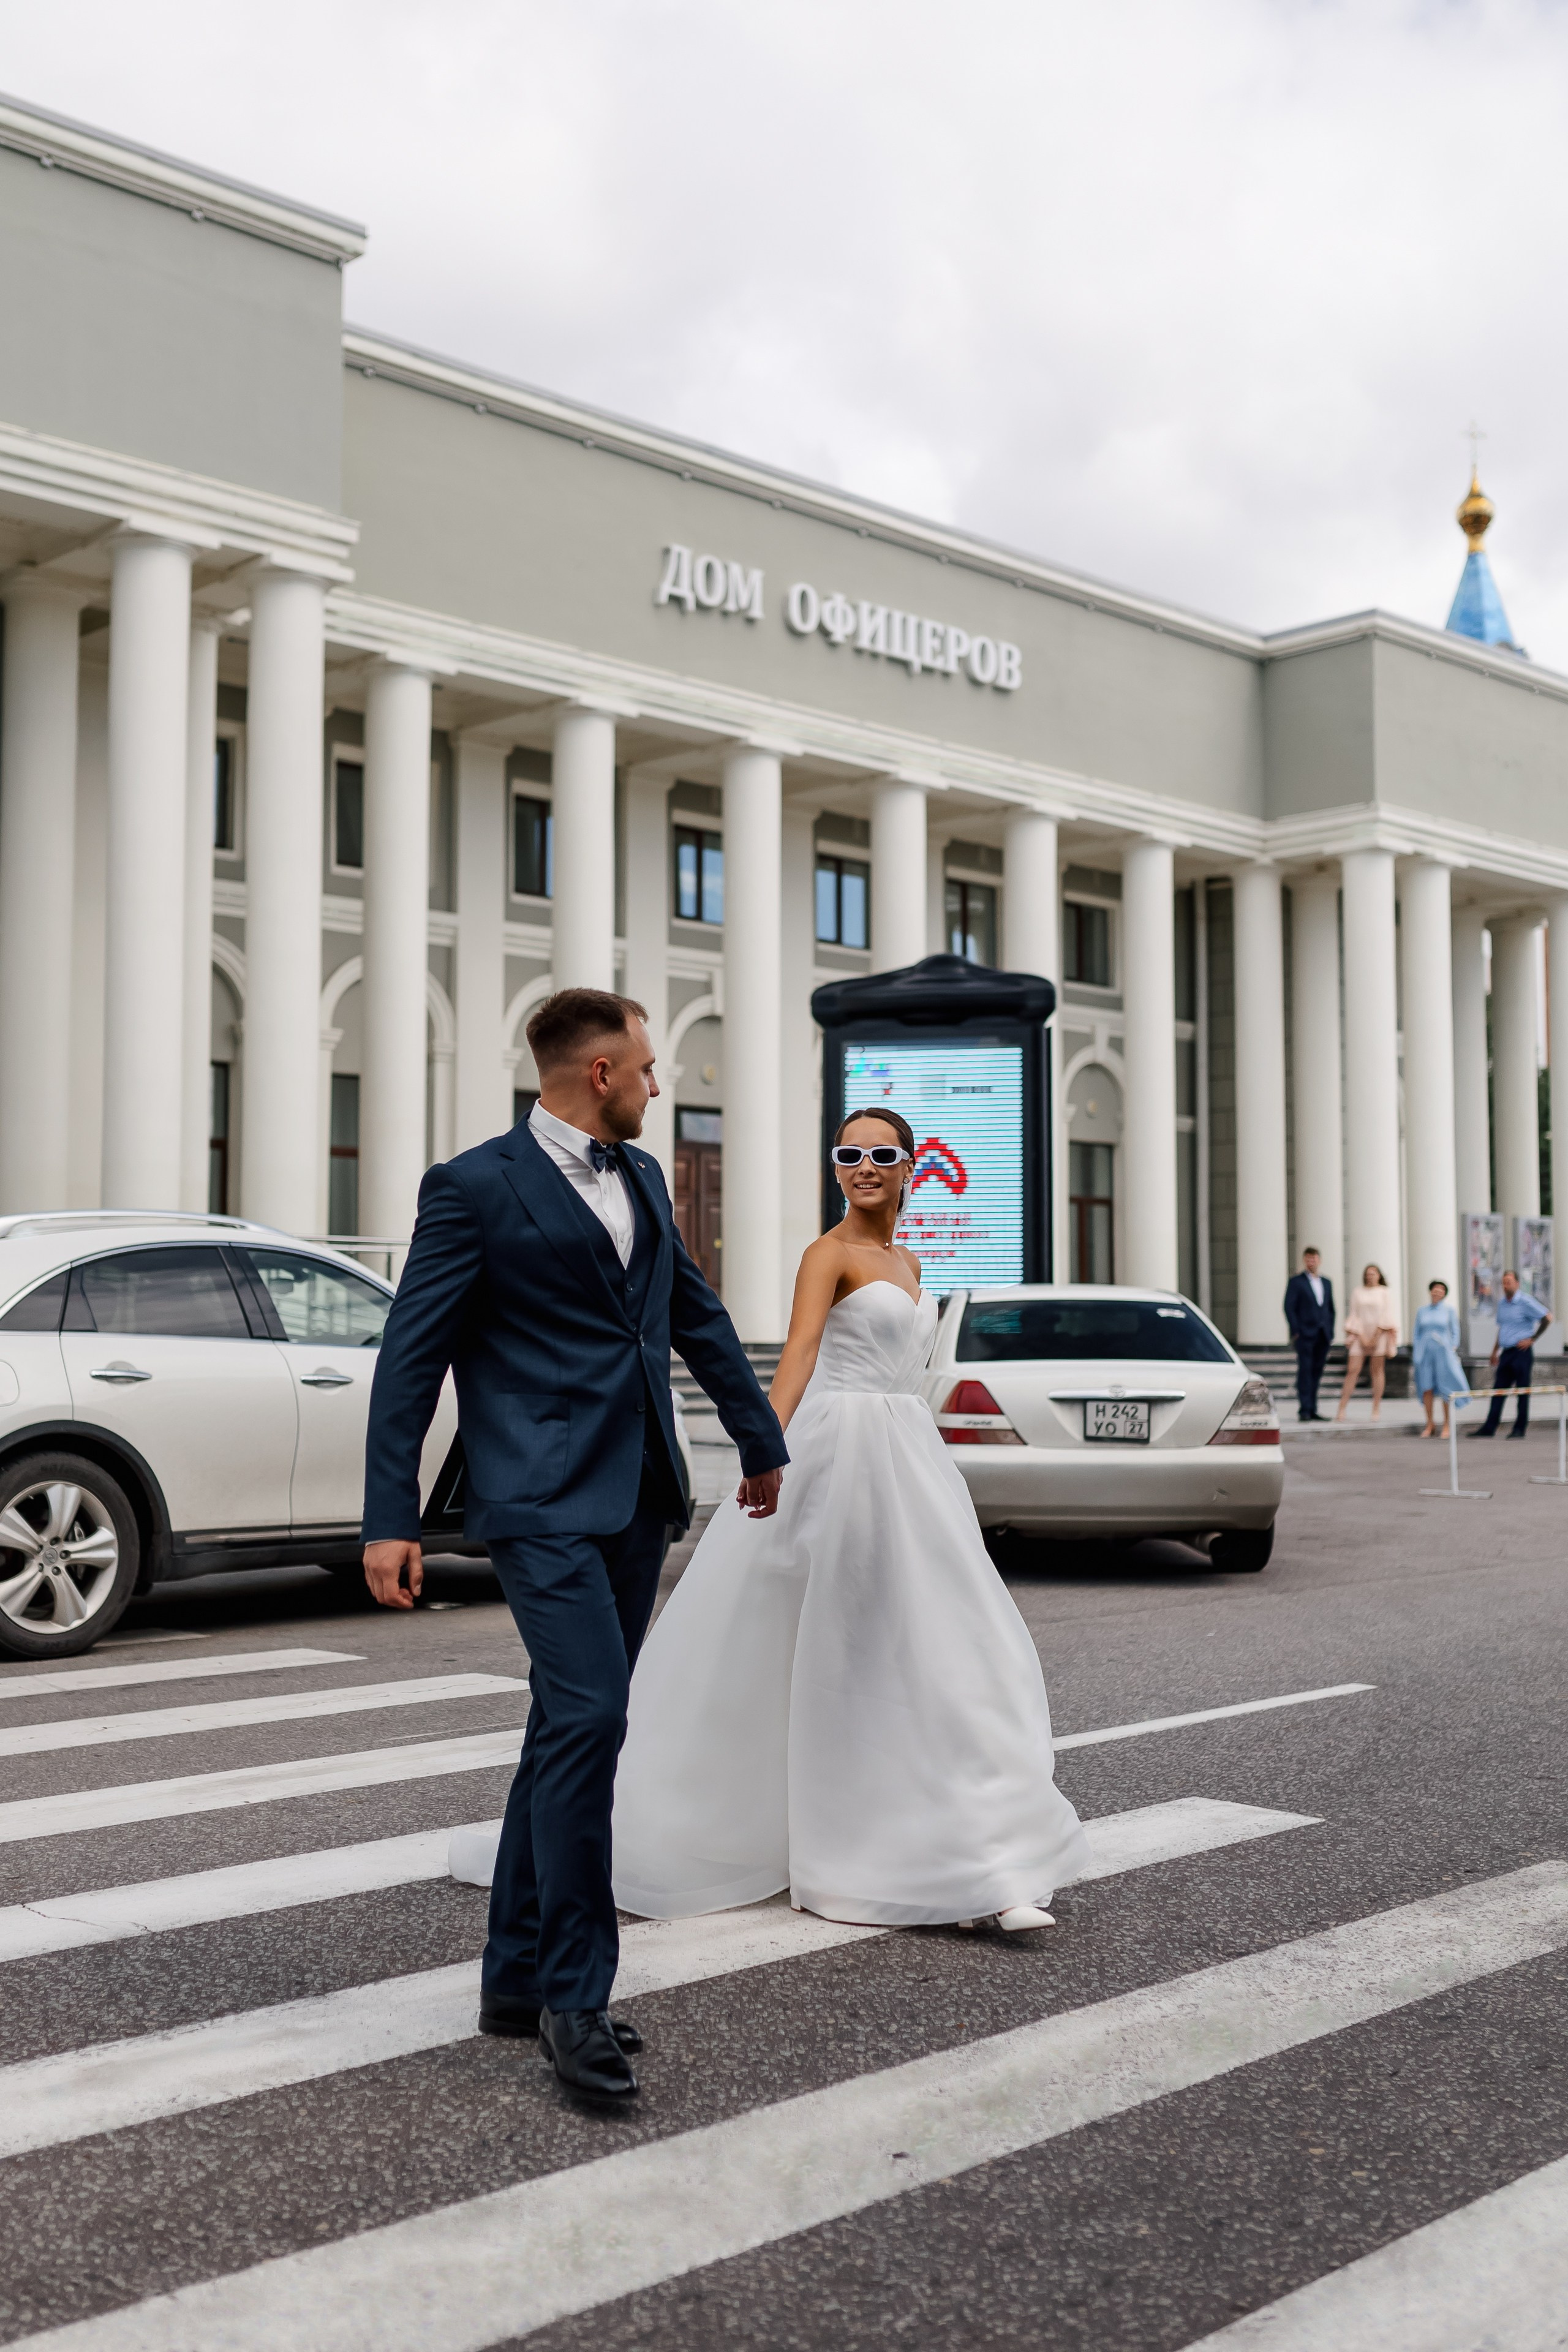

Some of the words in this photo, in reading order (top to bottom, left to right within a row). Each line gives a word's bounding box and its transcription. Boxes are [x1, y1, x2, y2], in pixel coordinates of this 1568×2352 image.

[655, 544, 766, 620] ДОМ
[786, 582, 1023, 692] ОФИЦЕРОВ
[1111, 1403, 1139, 1420] 242
[1129, 1423, 1144, 1434] 27
